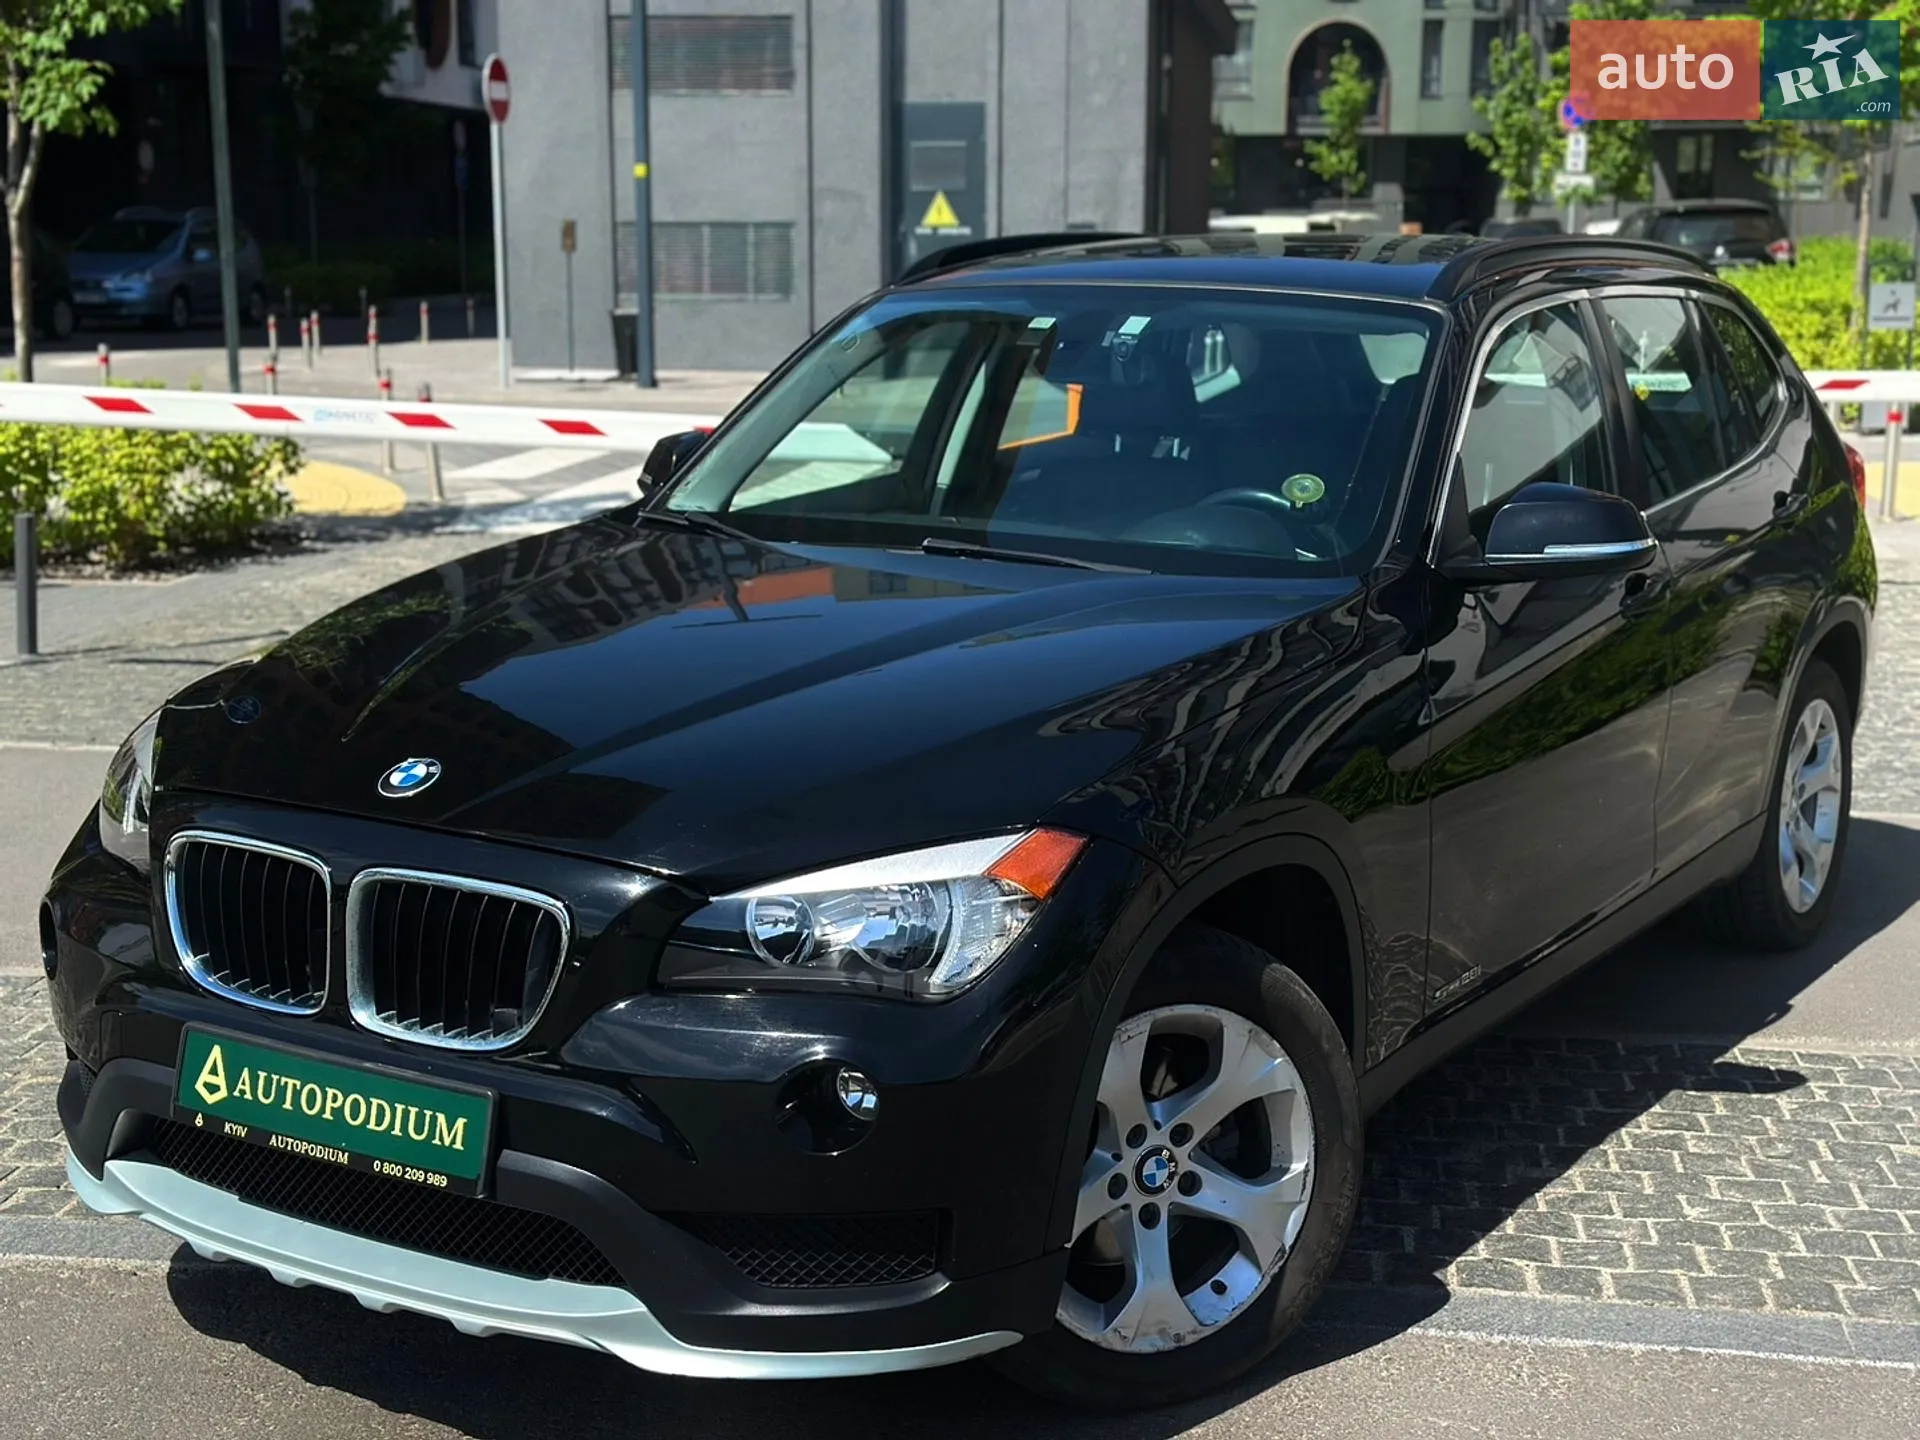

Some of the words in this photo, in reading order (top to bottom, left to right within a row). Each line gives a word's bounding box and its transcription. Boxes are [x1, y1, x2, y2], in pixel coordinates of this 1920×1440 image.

[232, 1066, 468, 1151] AUTOPODIUM
[223, 1121, 248, 1138] KYIV
[269, 1134, 349, 1165] AUTOPODIUM
[373, 1160, 381, 1172] 0
[382, 1162, 403, 1177] 800
[404, 1167, 425, 1182] 209
[426, 1172, 448, 1187] 989
